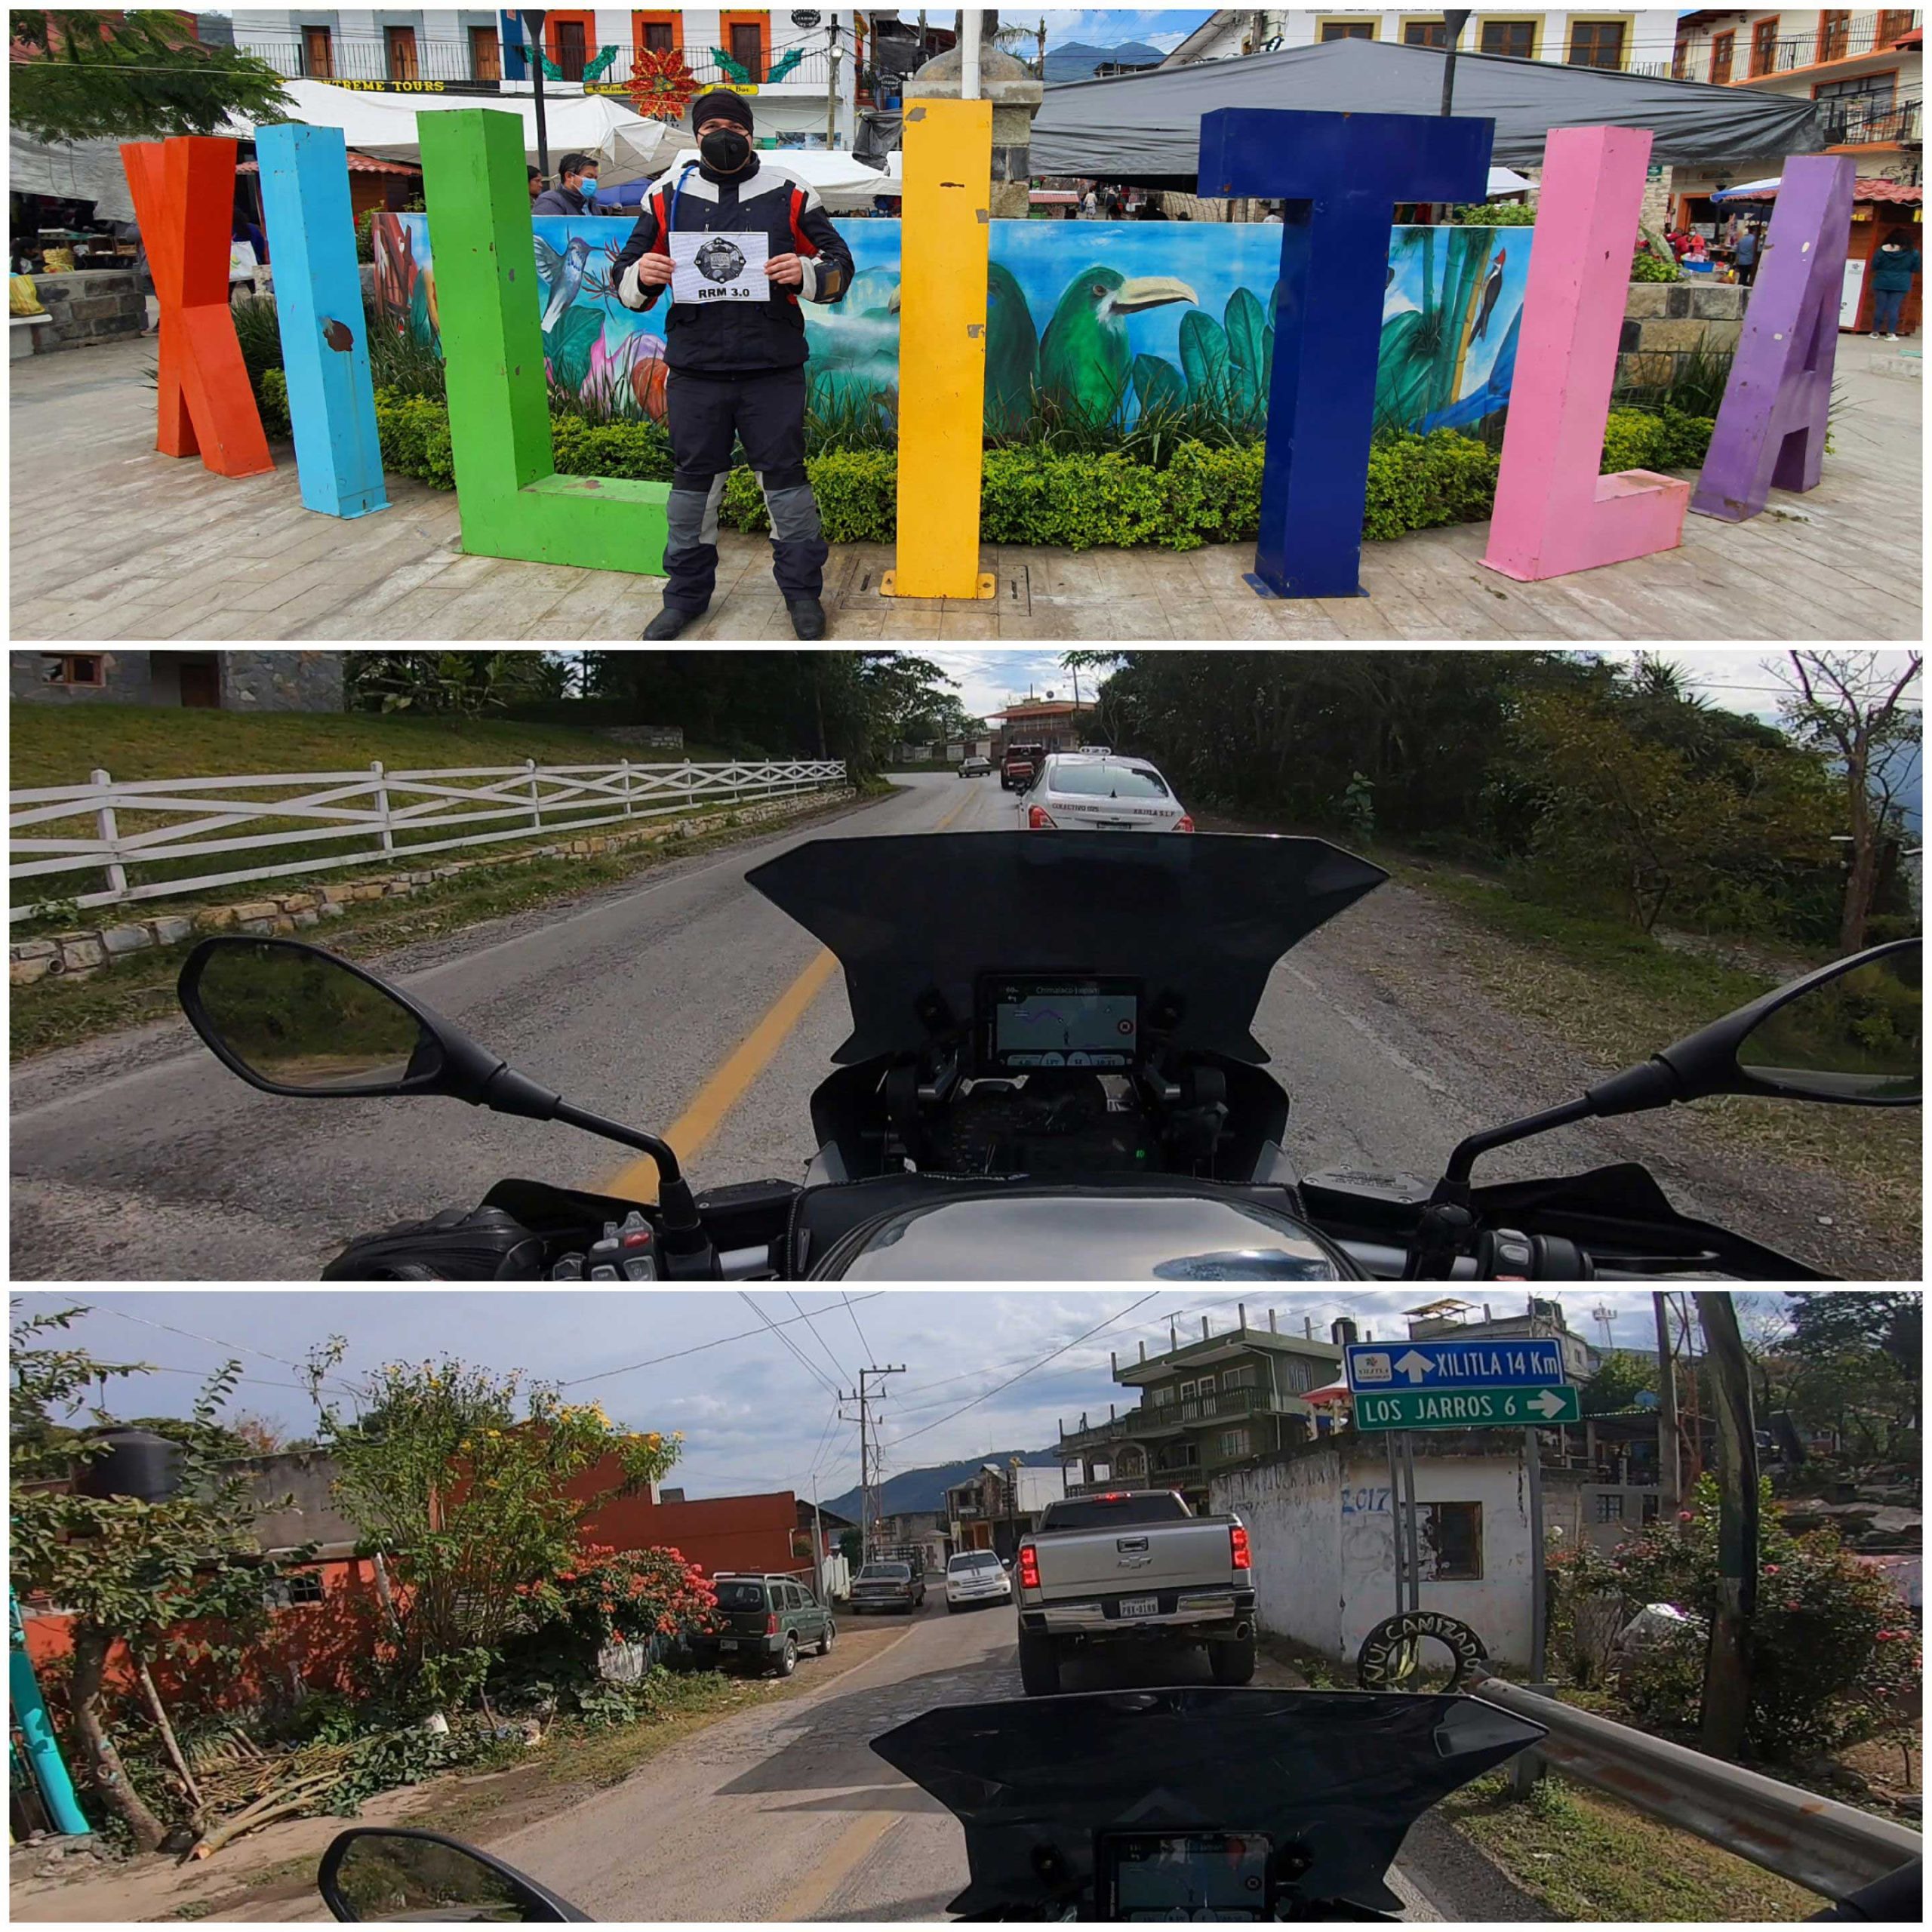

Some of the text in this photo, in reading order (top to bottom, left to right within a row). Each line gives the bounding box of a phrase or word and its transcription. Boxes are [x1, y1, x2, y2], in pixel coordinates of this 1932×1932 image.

[318, 80, 445, 91] TREME TOURS
[698, 288, 750, 299] RRM 3.0
[120, 97, 1857, 601] XILITLA
[1052, 803, 1085, 811] COLECTIVO
[1435, 1351, 1559, 1378] XILITLA 14 Km
[1364, 1395, 1516, 1423] LOS JARROS 6
